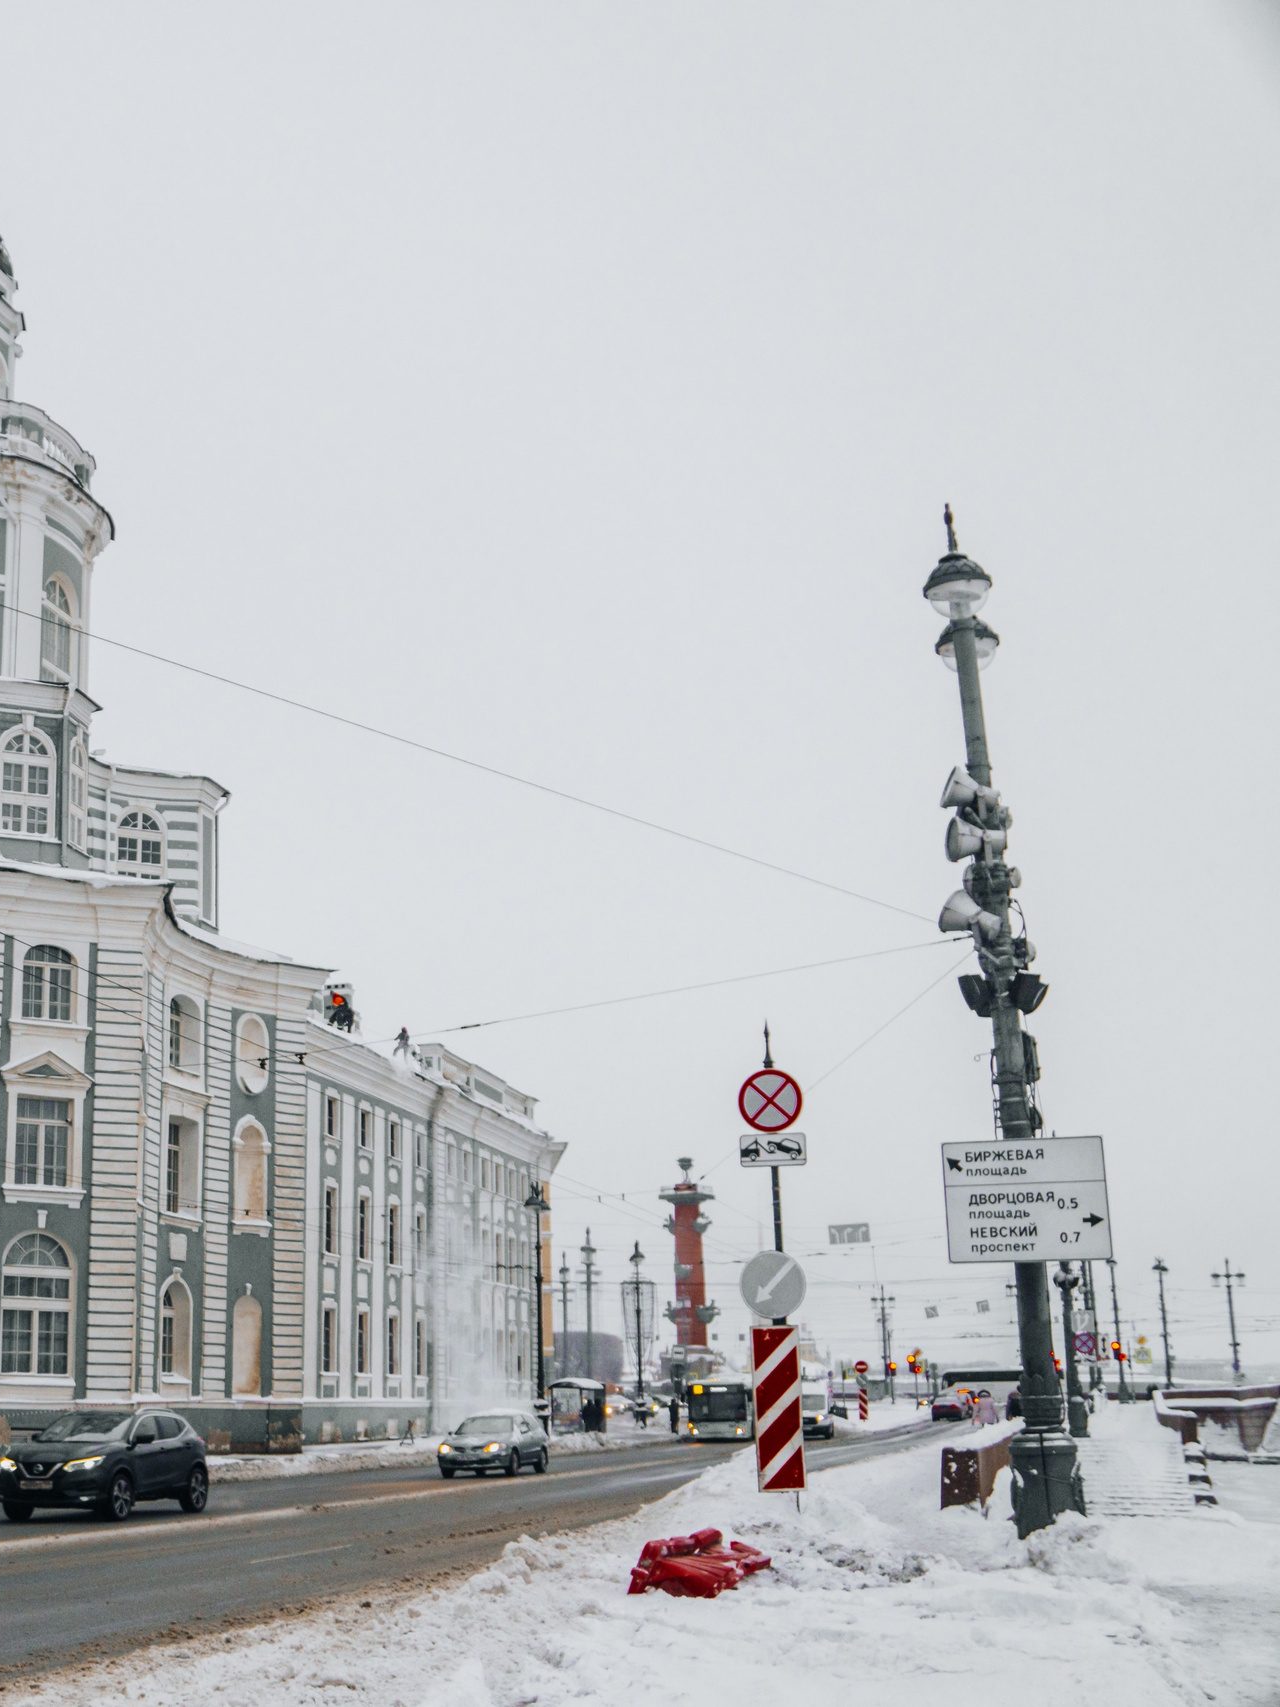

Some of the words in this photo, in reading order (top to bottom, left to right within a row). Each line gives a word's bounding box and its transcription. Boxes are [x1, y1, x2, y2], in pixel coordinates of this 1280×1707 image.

[965, 1149, 1044, 1162] БИРЖЕВАЯ
[966, 1167, 1027, 1177] площадь
[968, 1191, 1055, 1207] ДВОРЦОВАЯ
[1057, 1198, 1079, 1210] 0.5
[969, 1210, 1030, 1219] площадь
[970, 1222, 1038, 1238] НЕВСКИЙ
[1060, 1232, 1081, 1243] 0.7
[971, 1242, 1036, 1255] проспект
